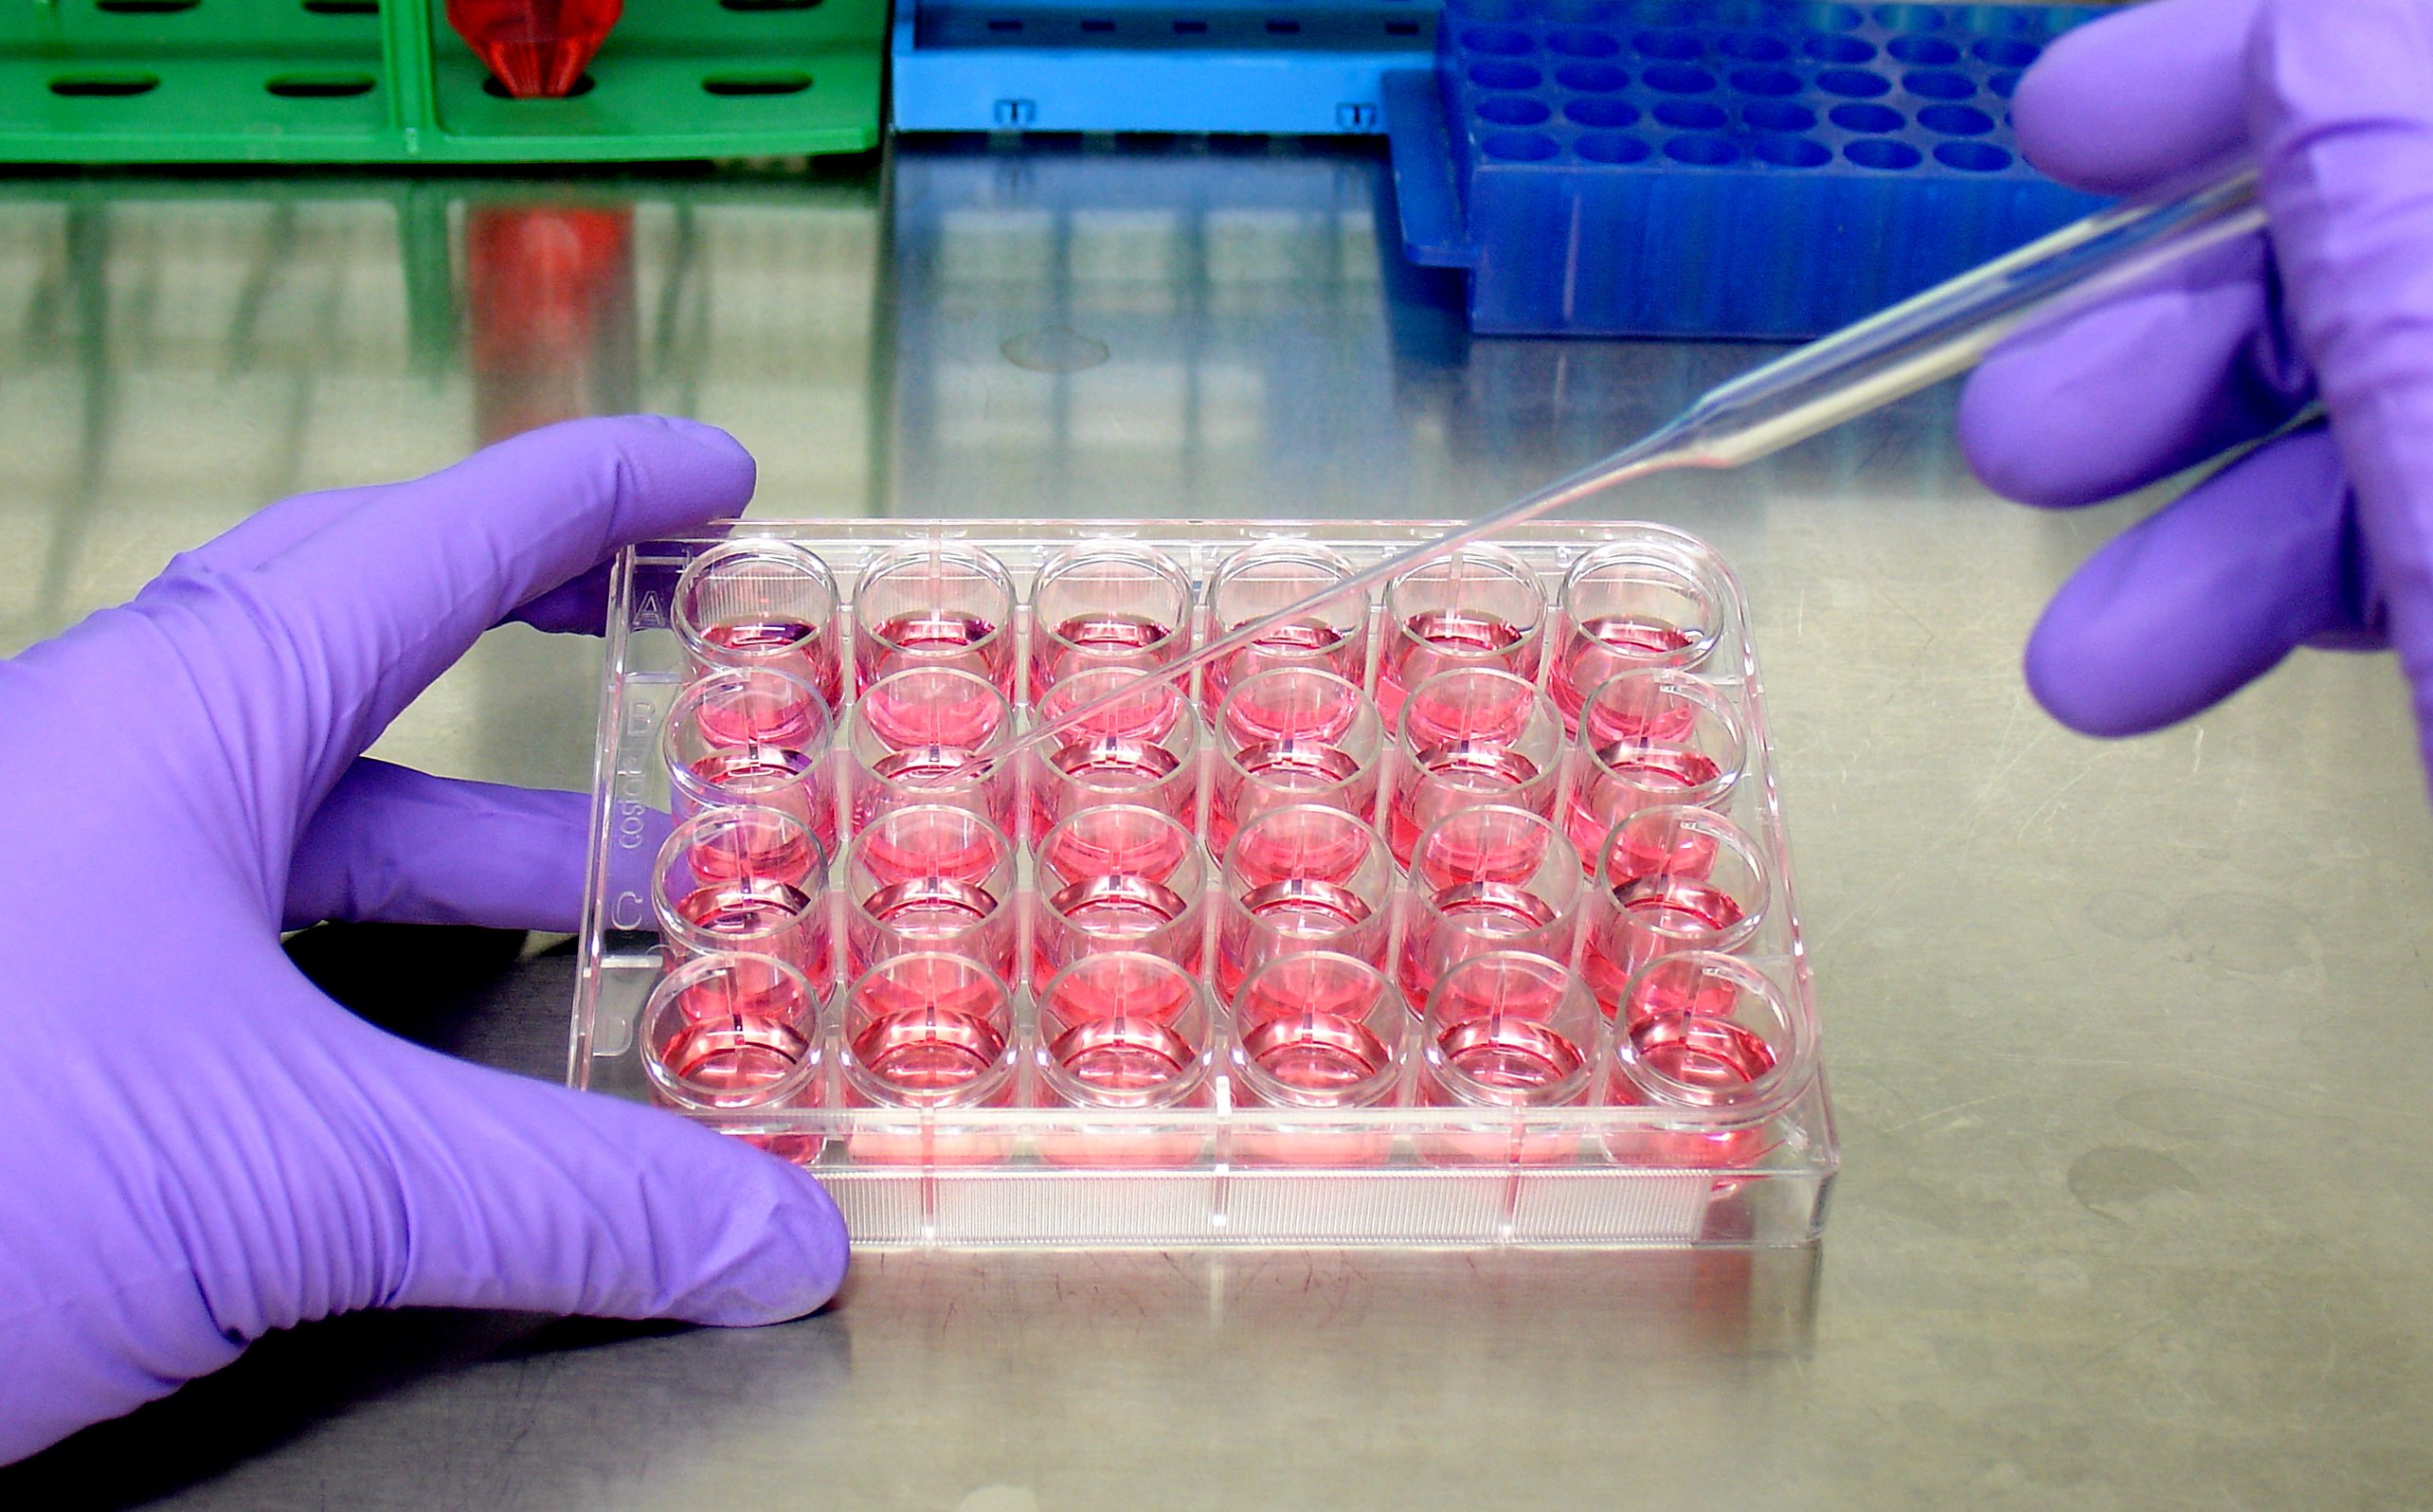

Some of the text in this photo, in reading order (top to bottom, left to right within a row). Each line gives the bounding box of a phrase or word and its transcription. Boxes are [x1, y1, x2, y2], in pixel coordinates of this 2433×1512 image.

[632, 590, 666, 627] A
[626, 699, 657, 736] B
[611, 891, 643, 930] C
